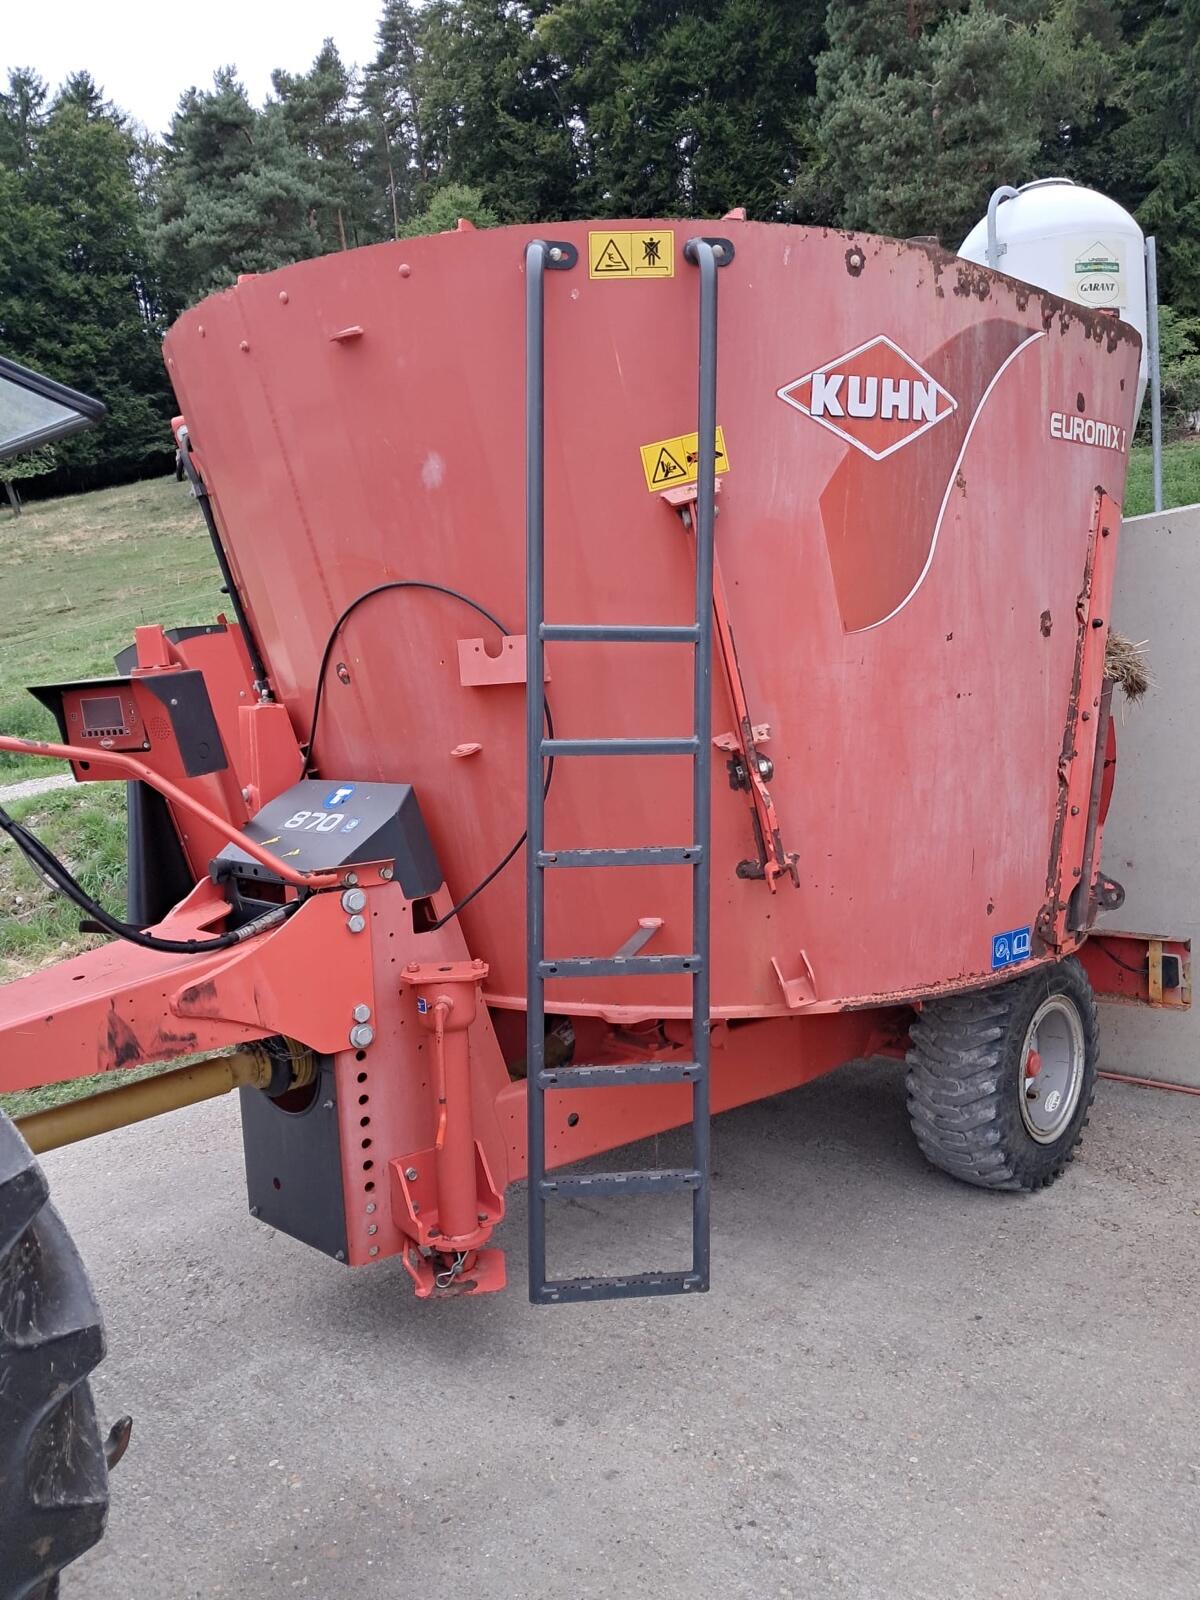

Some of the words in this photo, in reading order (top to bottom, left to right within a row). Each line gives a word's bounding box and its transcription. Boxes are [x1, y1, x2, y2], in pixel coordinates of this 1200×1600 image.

[1080, 283, 1115, 292] GARANT
[810, 373, 937, 423] KUHN
[1050, 412, 1120, 450] EUROMIX
[284, 811, 345, 832] 870
